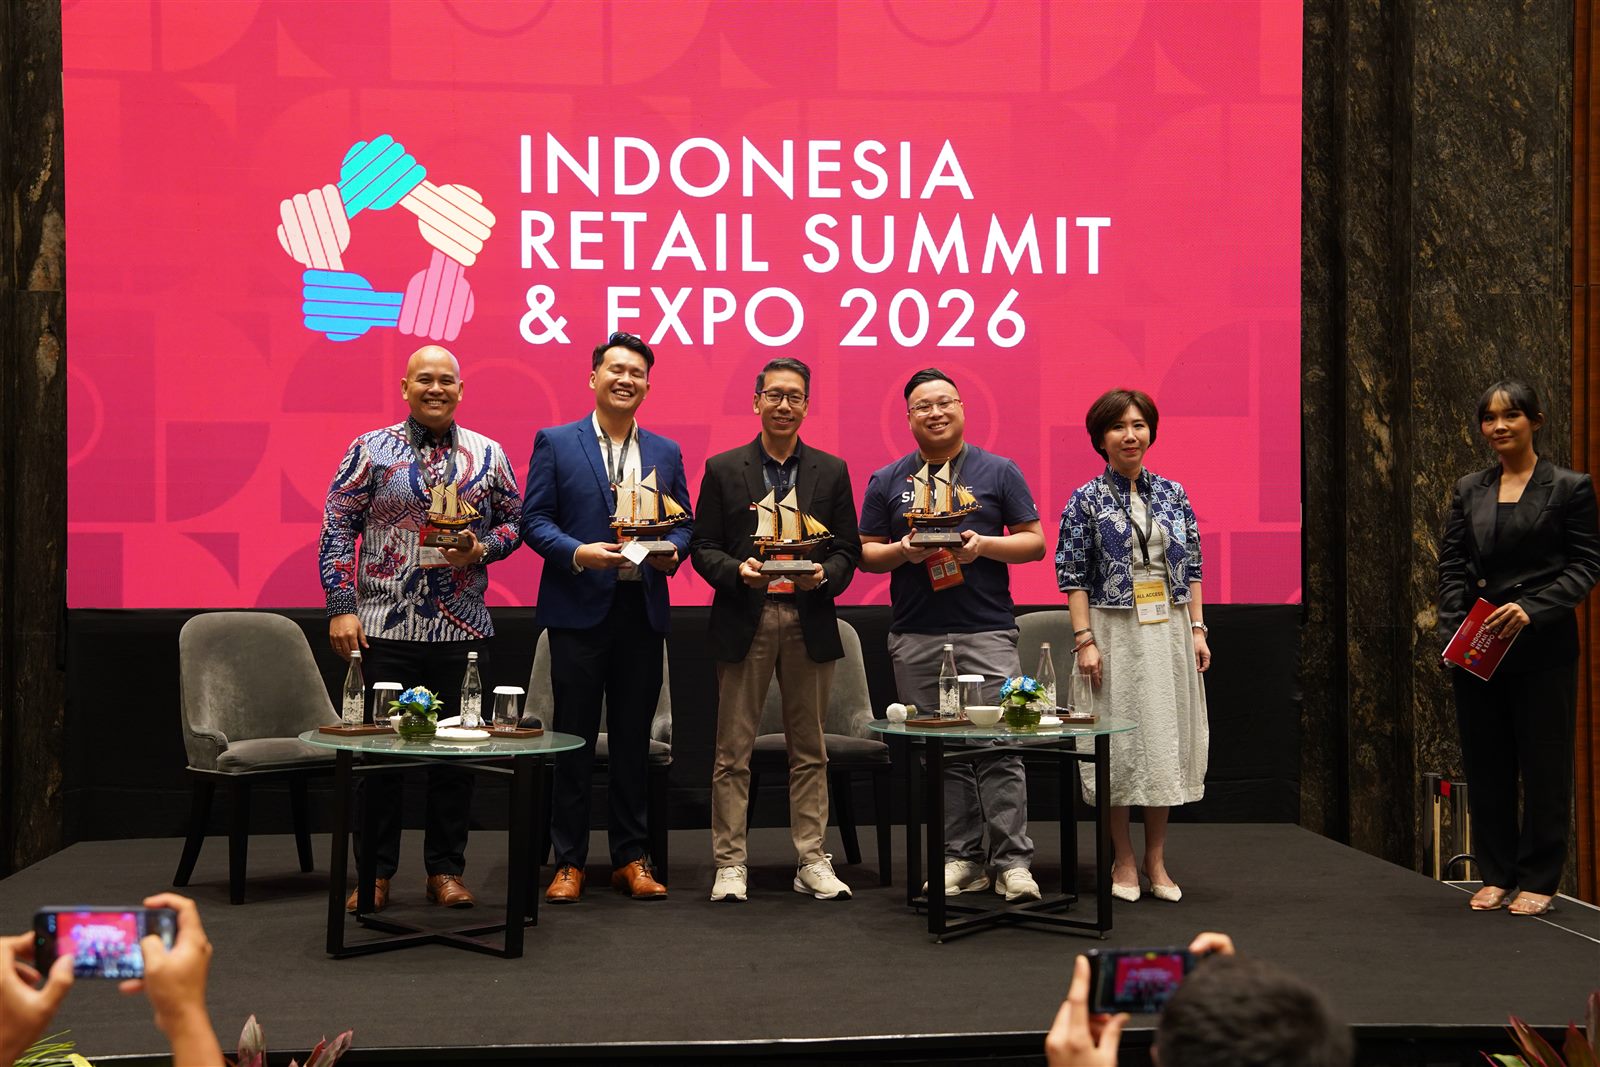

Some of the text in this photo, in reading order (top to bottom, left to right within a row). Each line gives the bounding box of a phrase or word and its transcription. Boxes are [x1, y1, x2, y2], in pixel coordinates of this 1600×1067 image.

[520, 132, 975, 200] INDONESIA
[520, 209, 1111, 275] RETAIL SUMMIT
[519, 284, 1026, 348] & EXPO 2026
